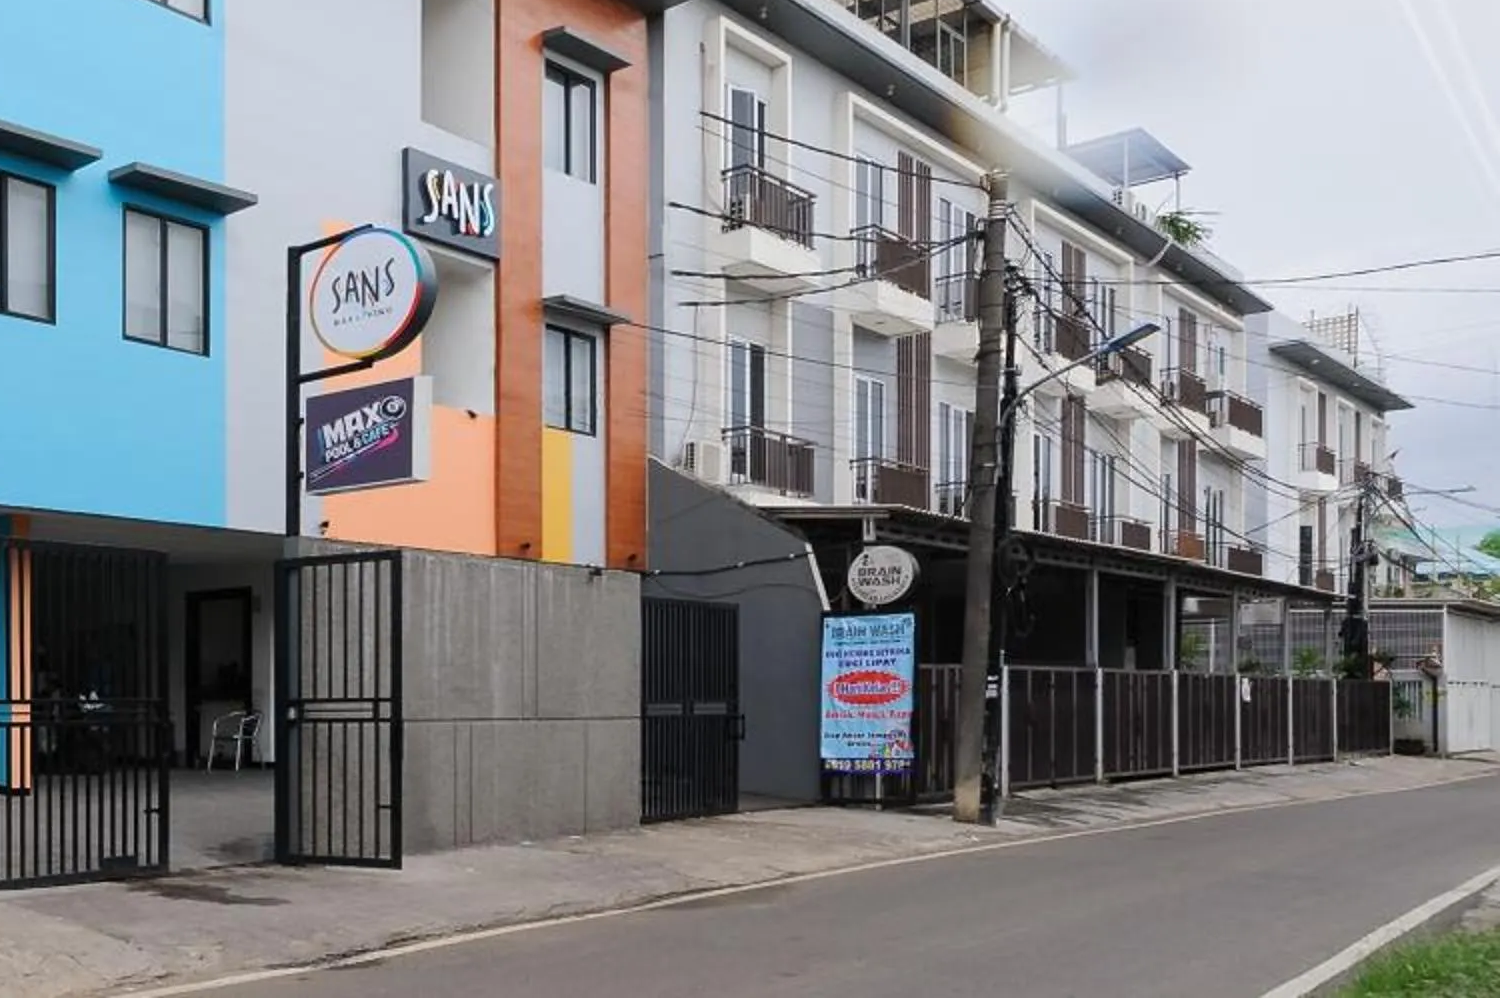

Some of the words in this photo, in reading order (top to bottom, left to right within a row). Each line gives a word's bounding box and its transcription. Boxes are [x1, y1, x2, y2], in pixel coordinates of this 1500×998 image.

[424, 169, 494, 237] SANS
[332, 257, 395, 314] SANS
[321, 401, 382, 449] MAX
[325, 442, 353, 463] POOL
[858, 576, 901, 586] WASH
[869, 622, 905, 637] WASH
